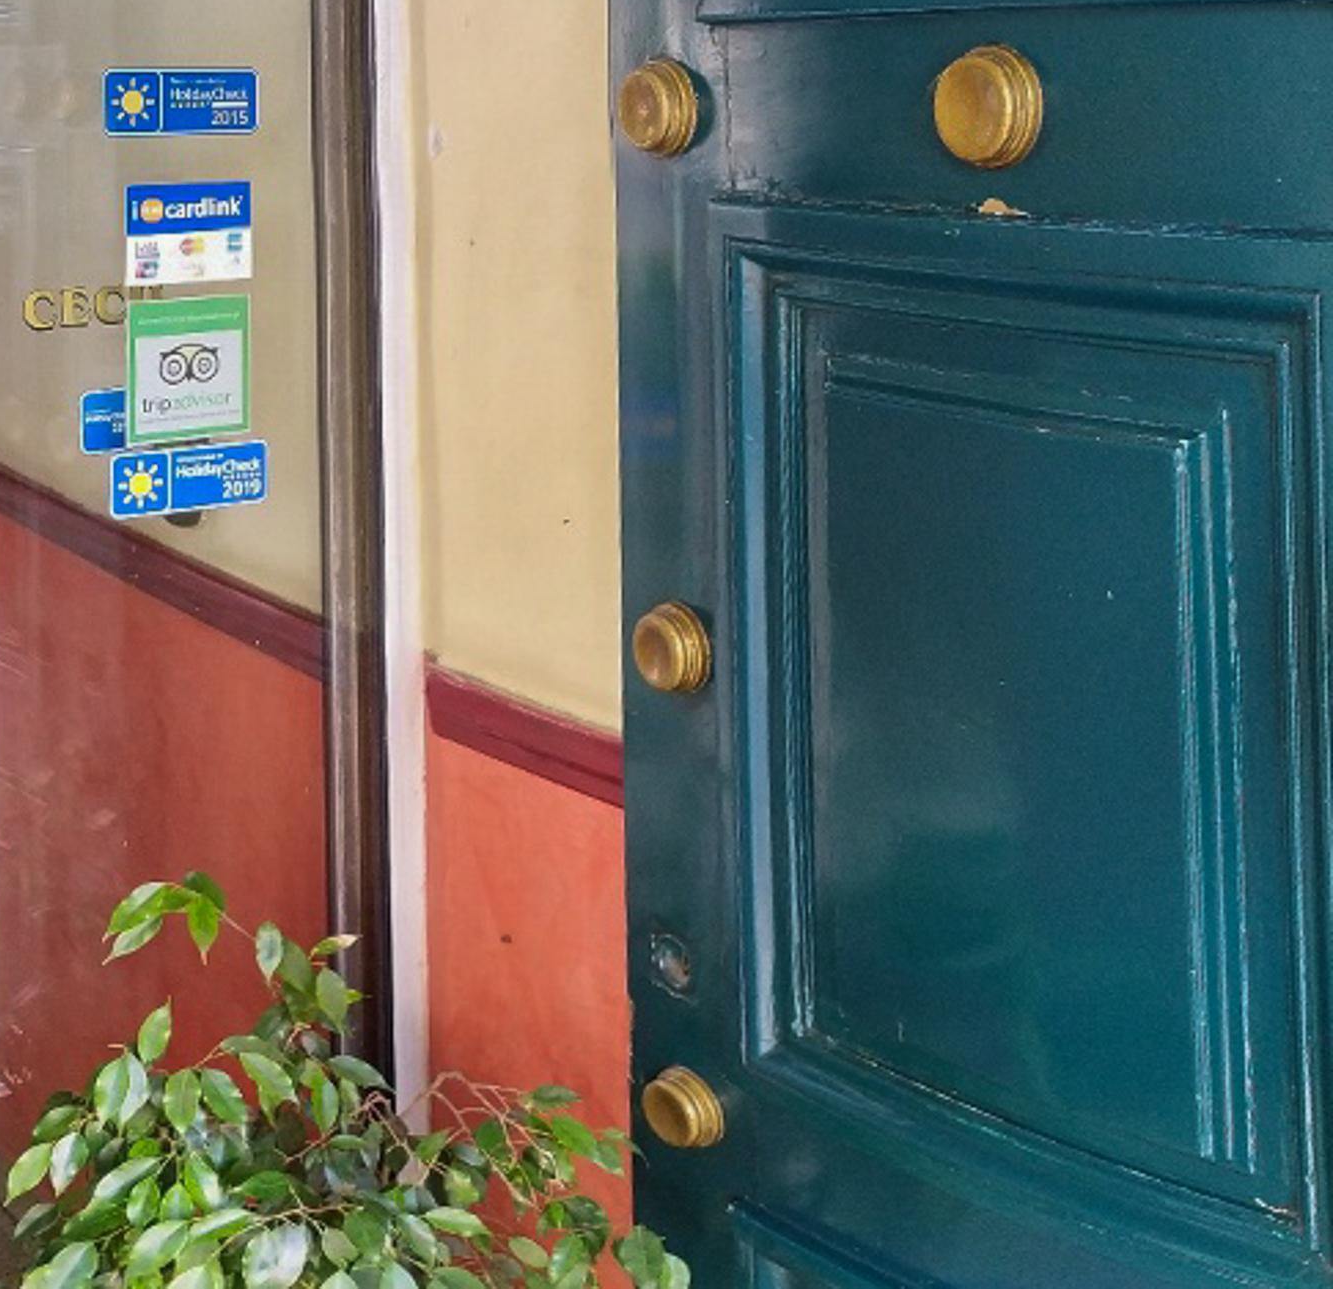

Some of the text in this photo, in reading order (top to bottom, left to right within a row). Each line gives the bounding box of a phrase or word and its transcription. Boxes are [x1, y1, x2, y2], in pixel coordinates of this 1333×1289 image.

[211, 110, 249, 125] 2015
[165, 195, 241, 219] cardlink
[142, 390, 233, 414] tripadvisor
[175, 456, 261, 479] HolidayCheck
[222, 479, 263, 499] 2019
